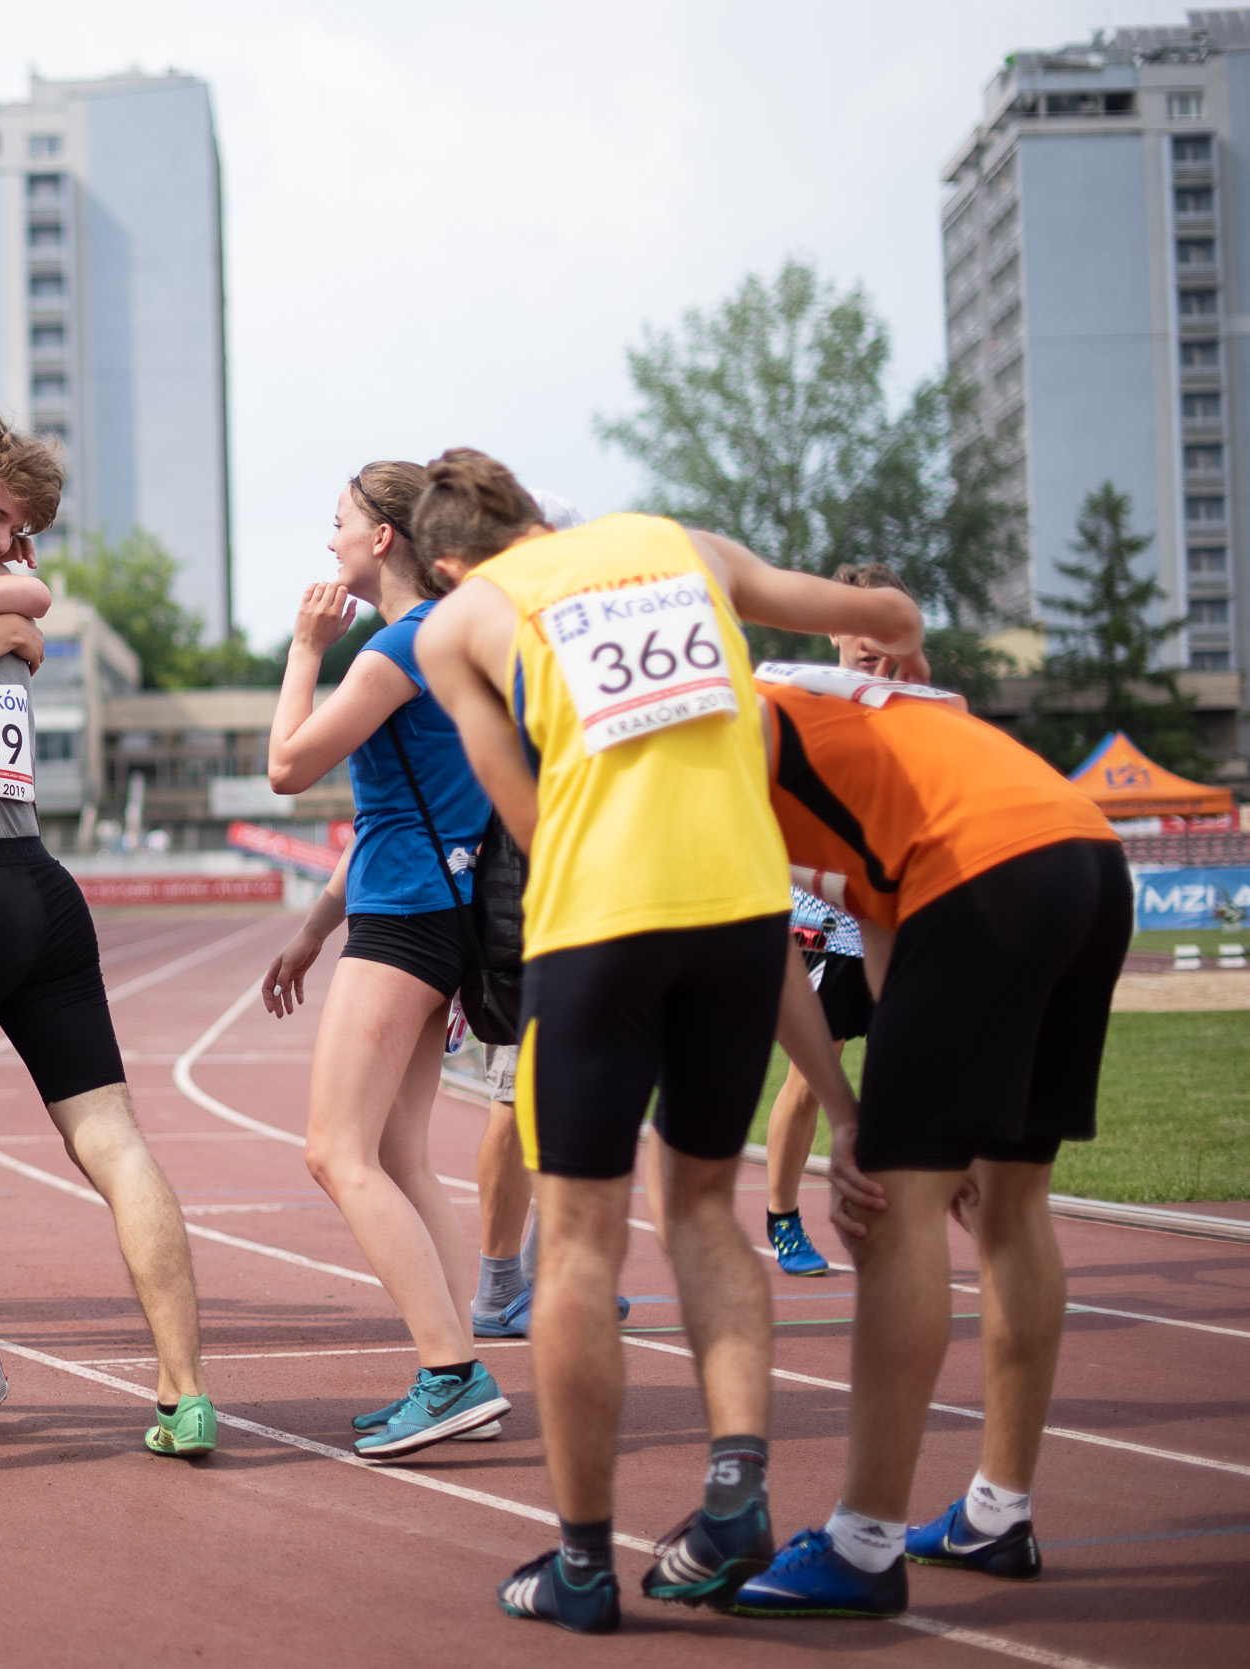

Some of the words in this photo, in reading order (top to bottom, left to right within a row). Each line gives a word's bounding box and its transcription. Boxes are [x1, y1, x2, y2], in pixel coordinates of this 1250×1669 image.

[590, 622, 720, 695] 366
[607, 702, 689, 738] KRAKÓW
[2, 784, 26, 798] 2019
[853, 1533, 892, 1550] adidas
